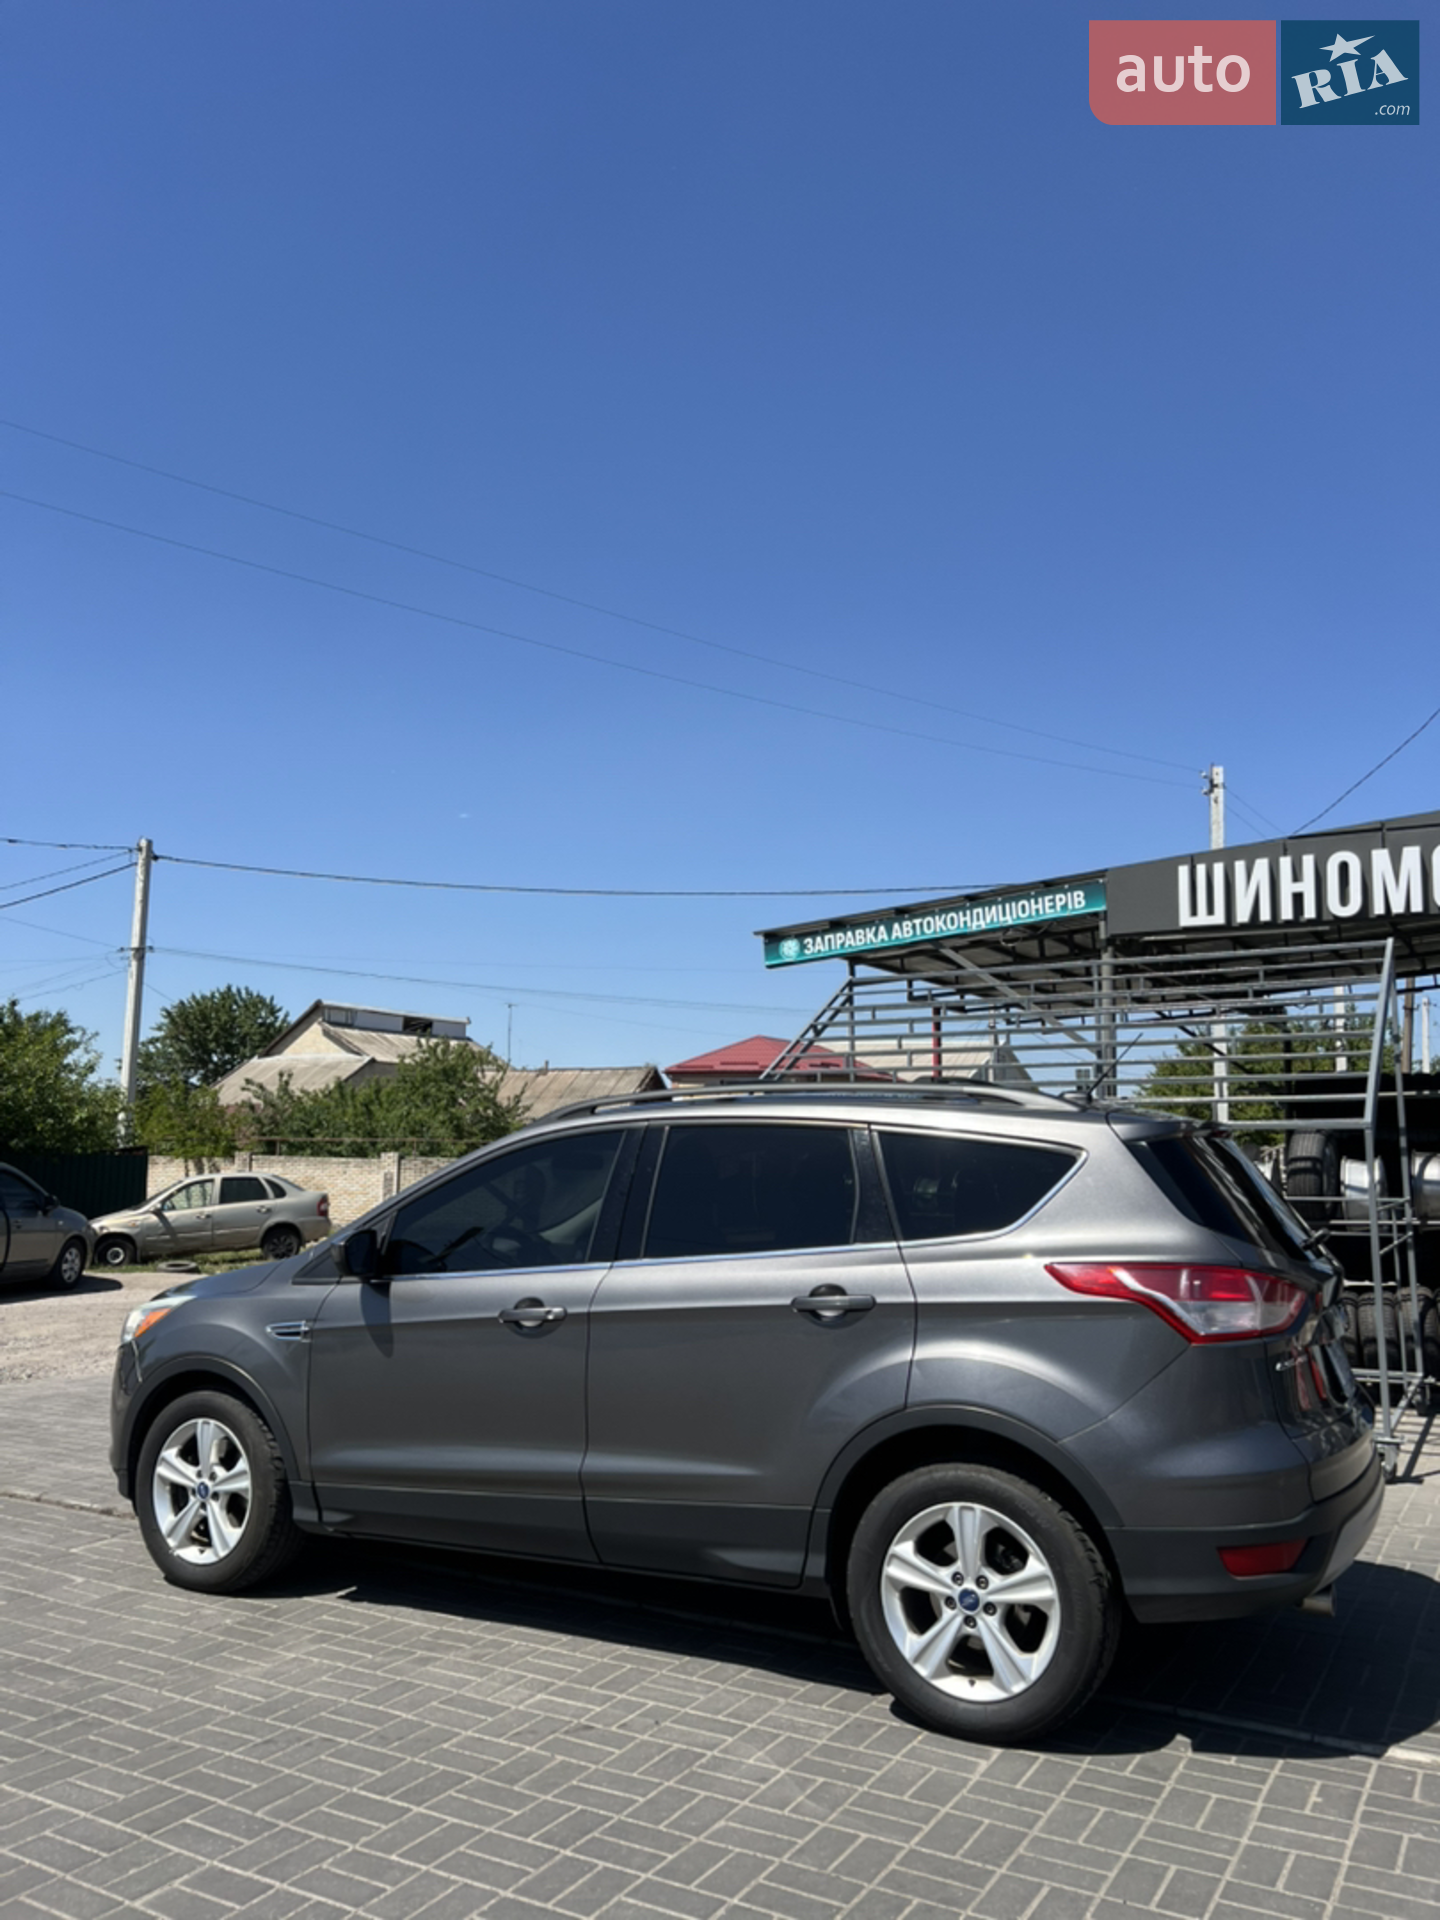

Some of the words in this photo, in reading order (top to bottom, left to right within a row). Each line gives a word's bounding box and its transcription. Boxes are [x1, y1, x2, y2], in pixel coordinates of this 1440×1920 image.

[803, 925, 889, 955] ЗАПРАВКА
[891, 890, 1086, 941] АВТОКОНДИЦІОНЕРІВ
[1178, 845, 1440, 927] ШИНОМ
